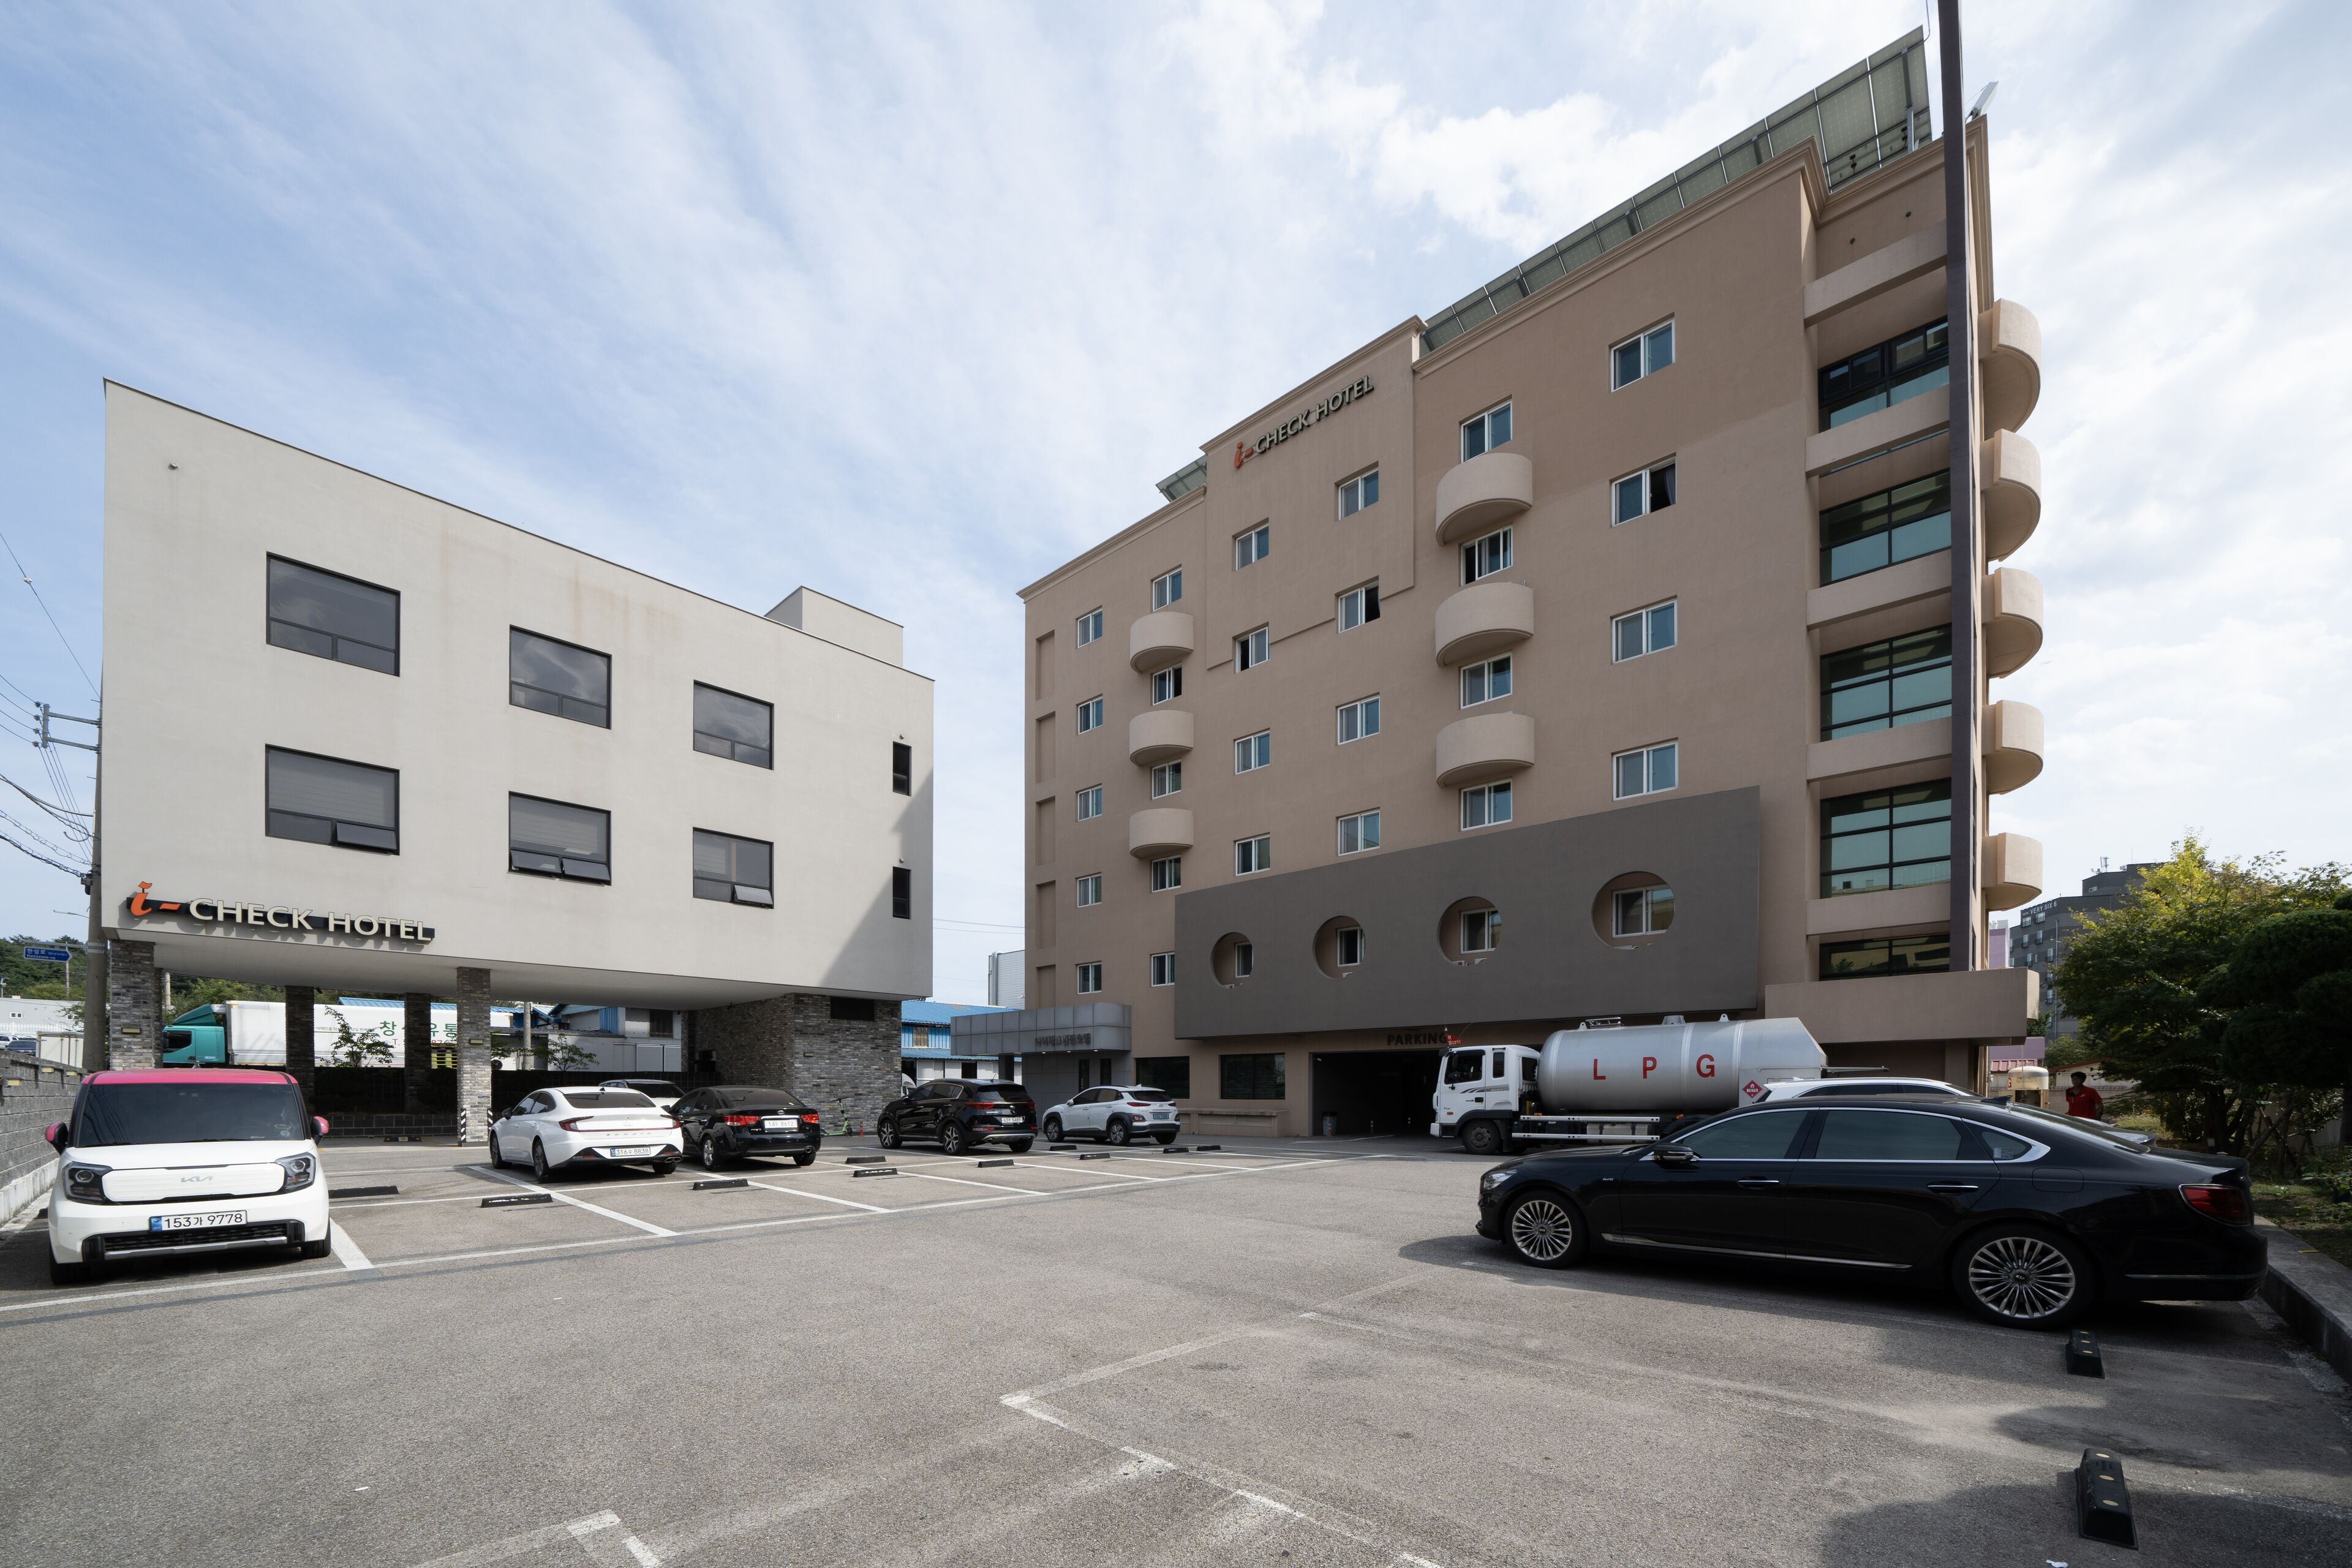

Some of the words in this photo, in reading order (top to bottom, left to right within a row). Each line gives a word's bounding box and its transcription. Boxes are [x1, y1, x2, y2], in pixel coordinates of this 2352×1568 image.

[1234, 409, 1310, 469] i-CHECK
[1316, 375, 1374, 421] HOTEL
[129, 881, 313, 930] i-CHECK
[328, 911, 432, 942] HOTEL
[2030, 906, 2043, 914] VERY
[380, 1020, 457, 1038] 창유통
[1387, 1033, 1447, 1046] PARKING
[164, 1217, 203, 1229] 153가
[207, 1213, 243, 1226] 9778
